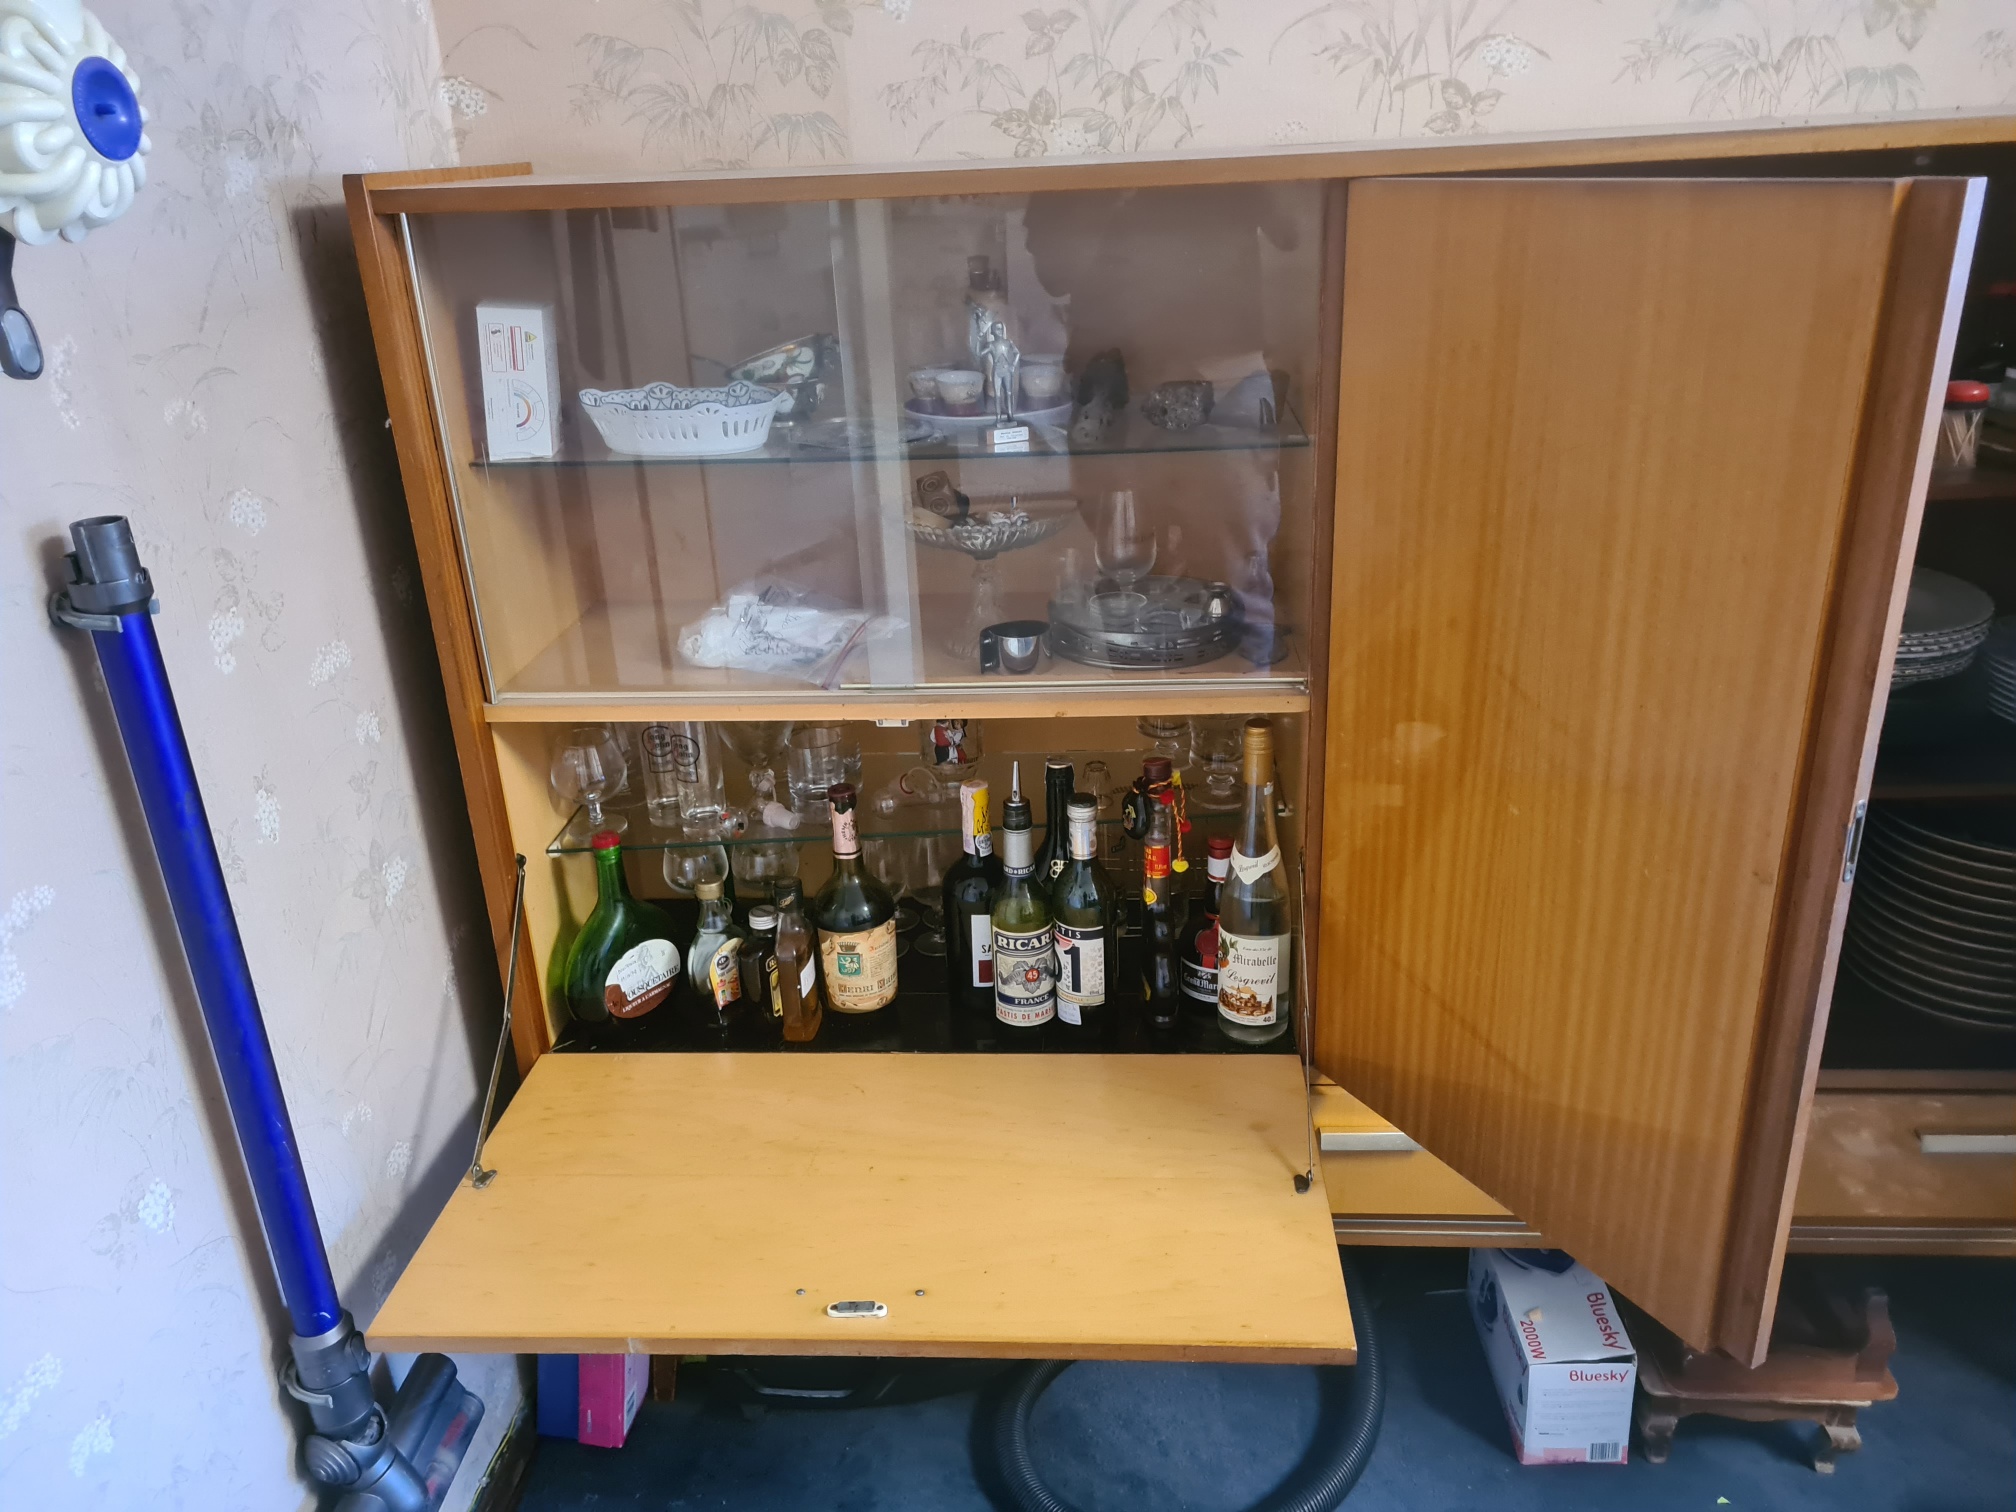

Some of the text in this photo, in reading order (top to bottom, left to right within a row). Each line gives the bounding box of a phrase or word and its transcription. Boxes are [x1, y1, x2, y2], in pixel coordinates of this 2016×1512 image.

[1056, 923, 1081, 939] STIS
[996, 932, 1051, 951] RICAR
[1232, 953, 1277, 967] Mirabelle
[628, 964, 680, 998] OUSQUETAIRE
[1027, 970, 1039, 980] 45
[1014, 993, 1050, 1005] FRANCE
[1022, 1012, 1031, 1020] DE
[1586, 1292, 1627, 1350] Bluesky
[1520, 1320, 1547, 1359] 2000W
[1569, 1369, 1629, 1382] Bluesky
